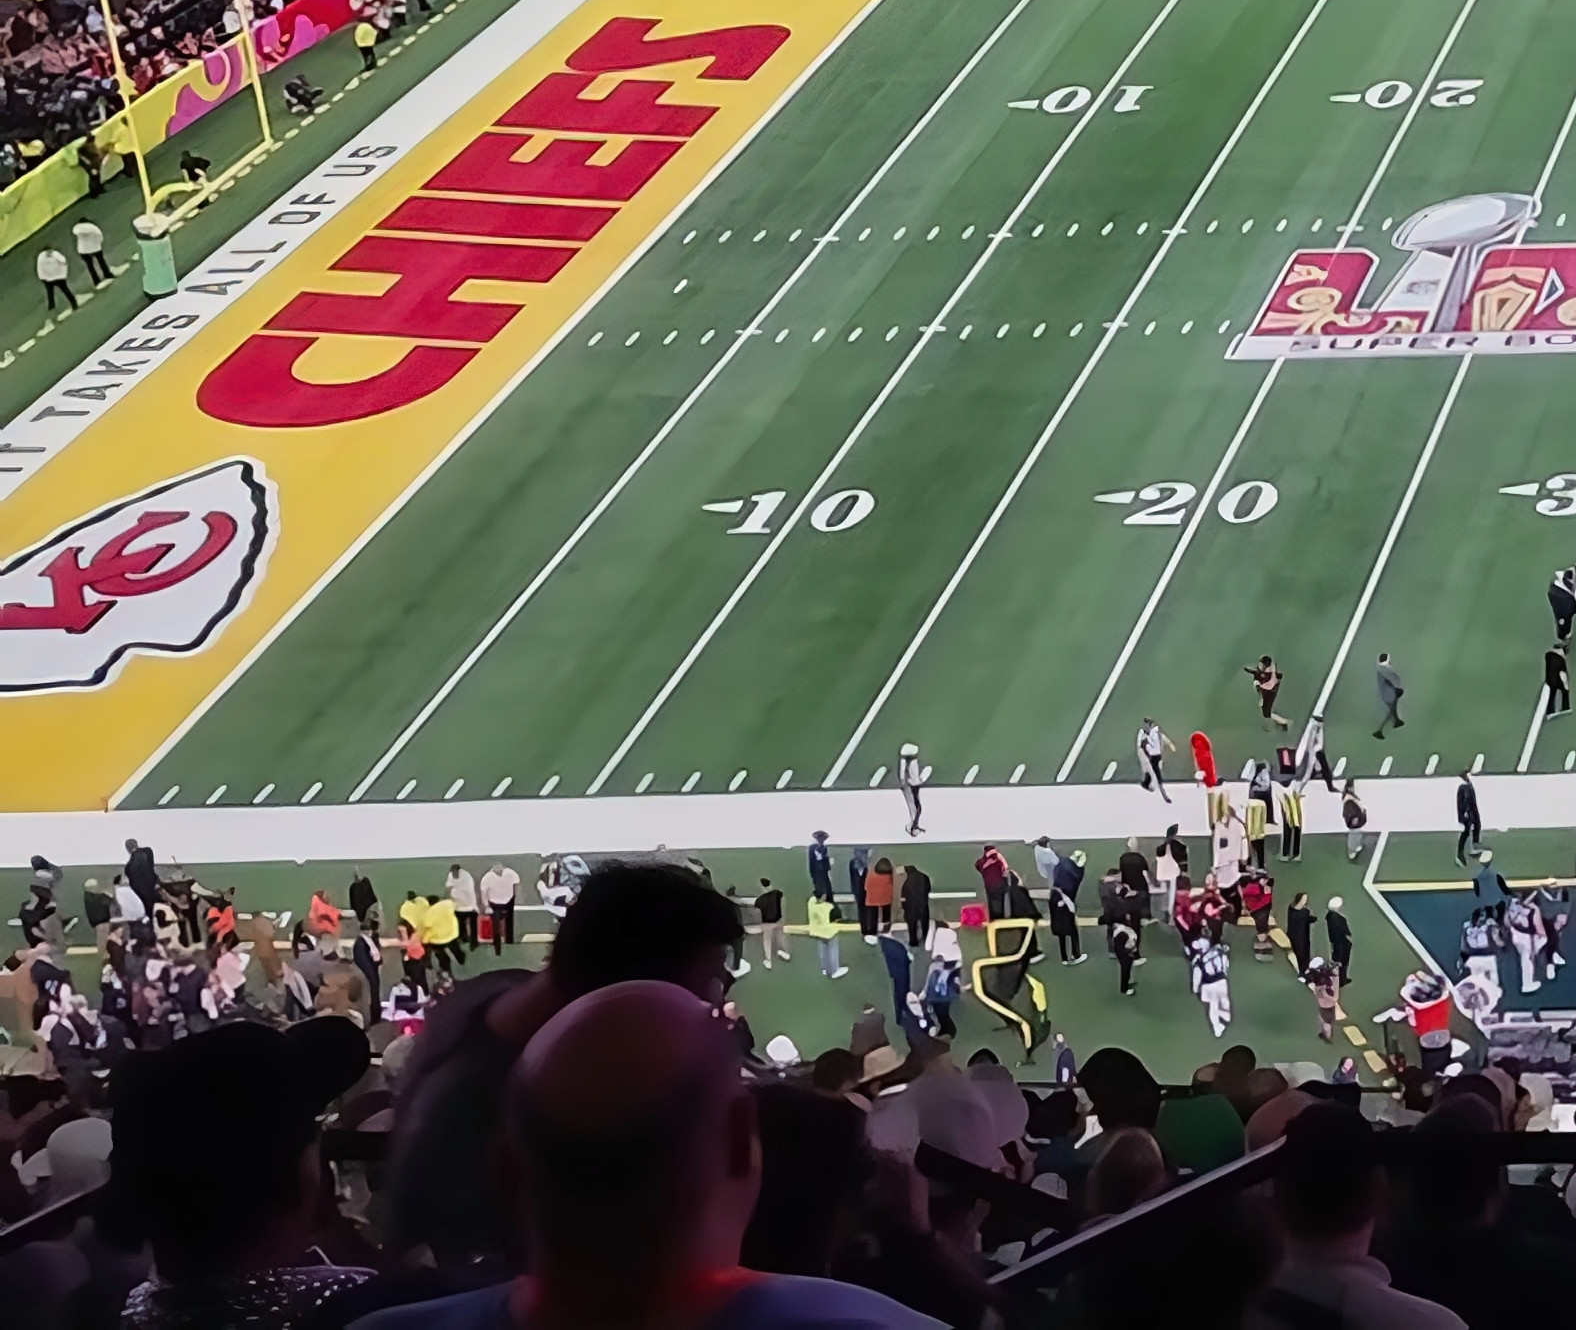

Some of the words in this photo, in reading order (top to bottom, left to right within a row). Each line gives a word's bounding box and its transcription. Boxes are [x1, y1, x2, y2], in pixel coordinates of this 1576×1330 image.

[30, 313, 200, 422] TAKES
[185, 240, 288, 295] ALL
[290, 191, 345, 226] OF
[322, 143, 398, 180] US
[197, 17, 791, 428] CHIEFS
[726, 488, 876, 537] 10
[1122, 480, 1279, 526] 20
